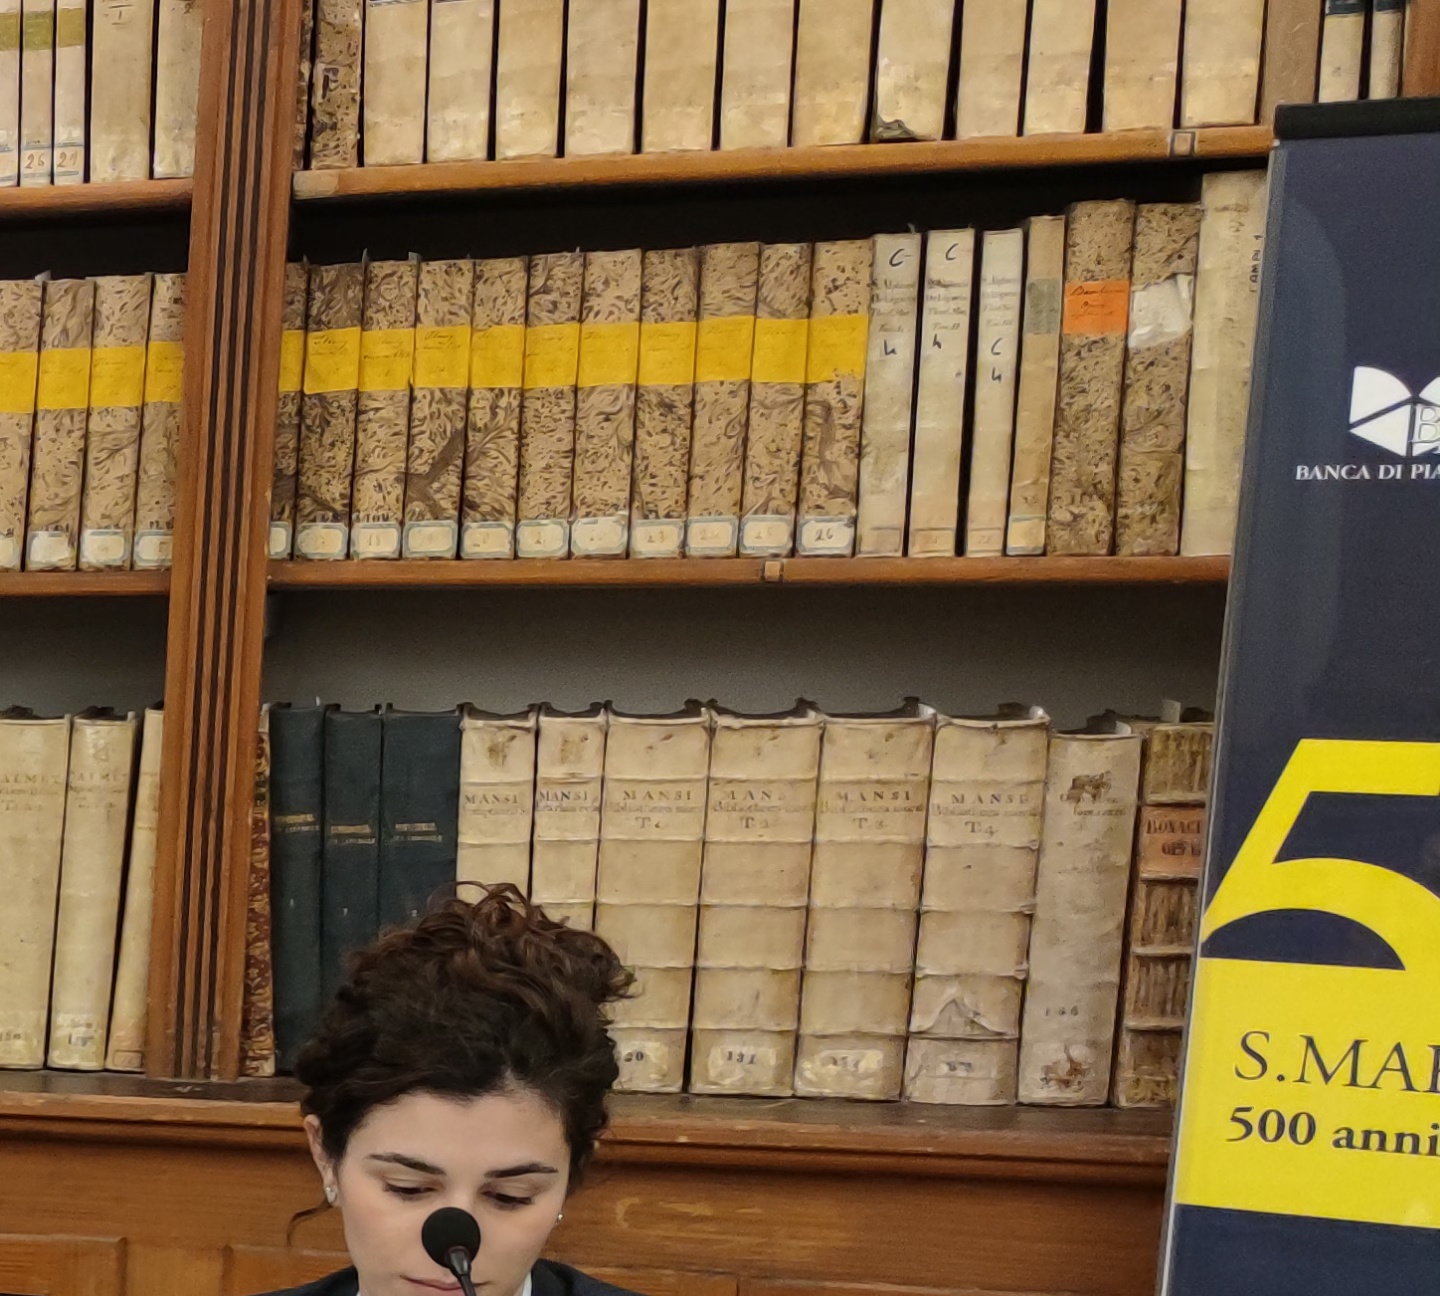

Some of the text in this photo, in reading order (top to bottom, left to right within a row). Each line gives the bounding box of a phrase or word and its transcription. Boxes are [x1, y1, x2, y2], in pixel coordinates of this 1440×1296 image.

[1295, 463, 1370, 481] BANCA
[1378, 463, 1402, 480] DI
[464, 793, 519, 805] MANSI
[537, 790, 588, 802] MANSI
[622, 789, 691, 801] MANSI
[1226, 1106, 1317, 1146] 500
